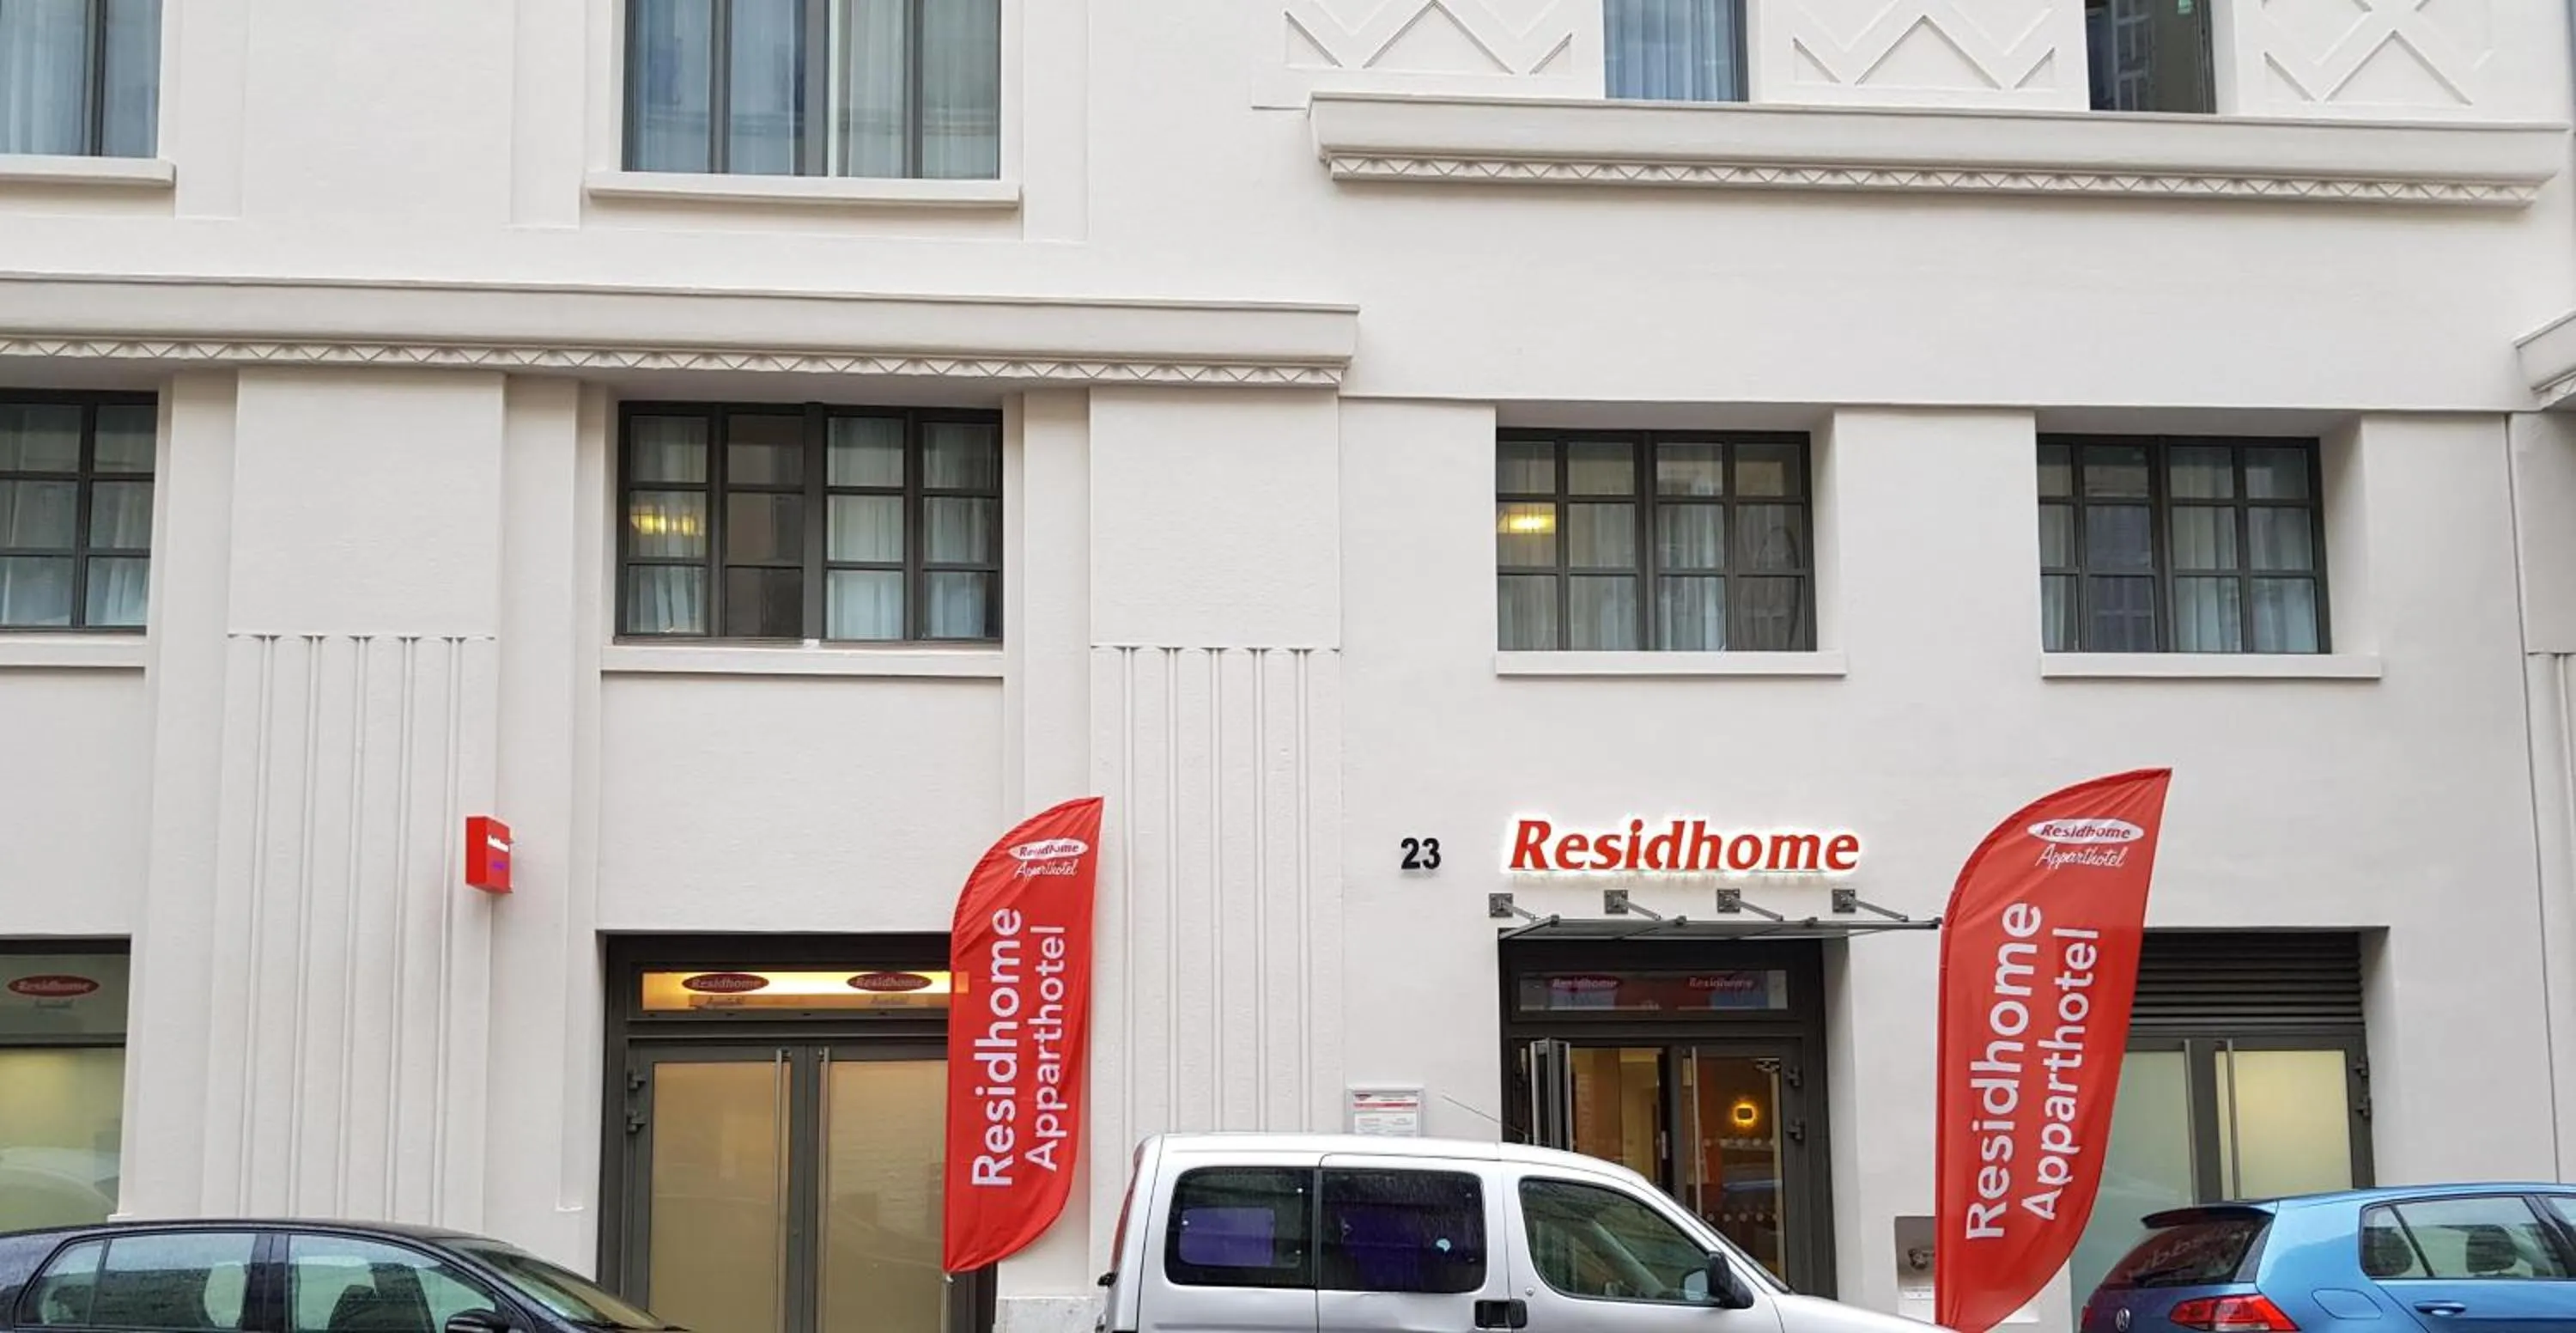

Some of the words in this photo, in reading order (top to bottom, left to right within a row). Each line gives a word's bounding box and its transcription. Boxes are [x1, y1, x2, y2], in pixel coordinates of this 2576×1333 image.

[1400, 838, 1442, 870] 23
[1510, 819, 1859, 871] Residhome
[2035, 843, 2129, 870] Apparthotel
[2041, 824, 2130, 839] Residhome
[971, 908, 1022, 1186] Residhome
[1024, 926, 1067, 1172] Apparthotel
[1965, 903, 2043, 1239] Residhome
[2021, 928, 2099, 1220] Apparthotel
